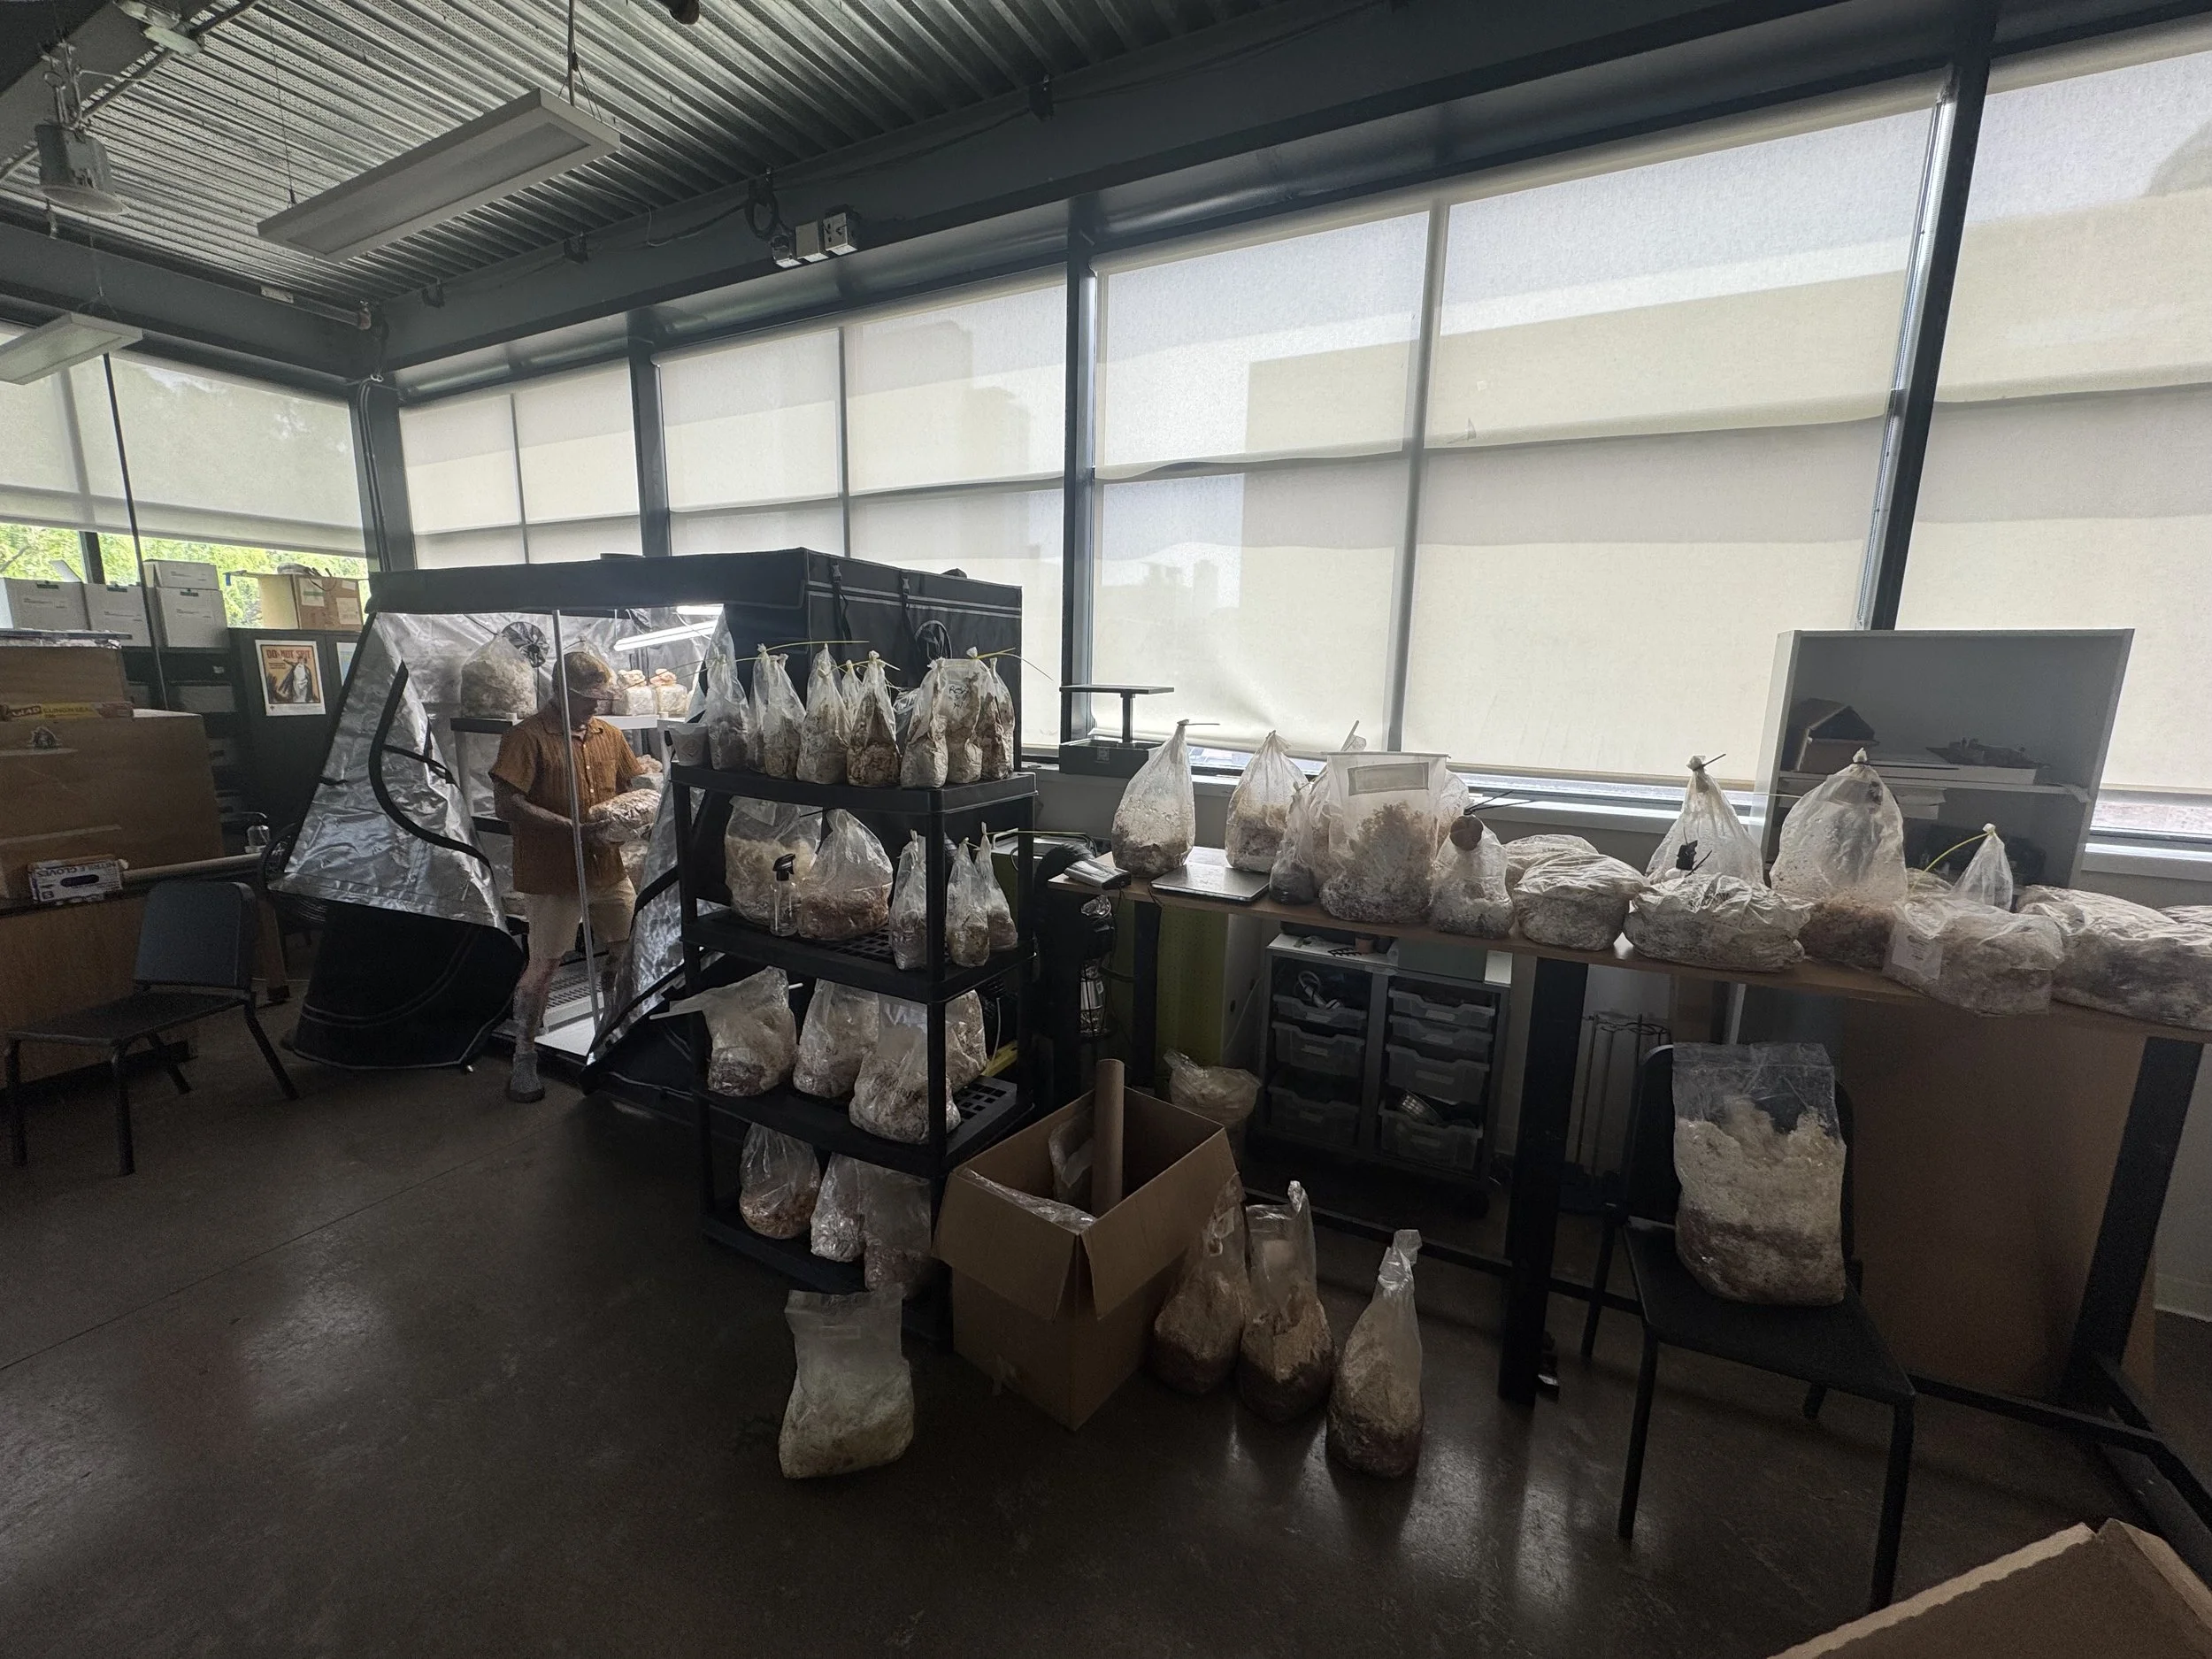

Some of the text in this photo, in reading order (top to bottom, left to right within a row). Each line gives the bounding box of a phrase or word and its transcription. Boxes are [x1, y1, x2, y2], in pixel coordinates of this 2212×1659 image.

[266, 649, 311, 659] DO NOT SPIT
[36, 861, 117, 877] NITRILE GLOVES
